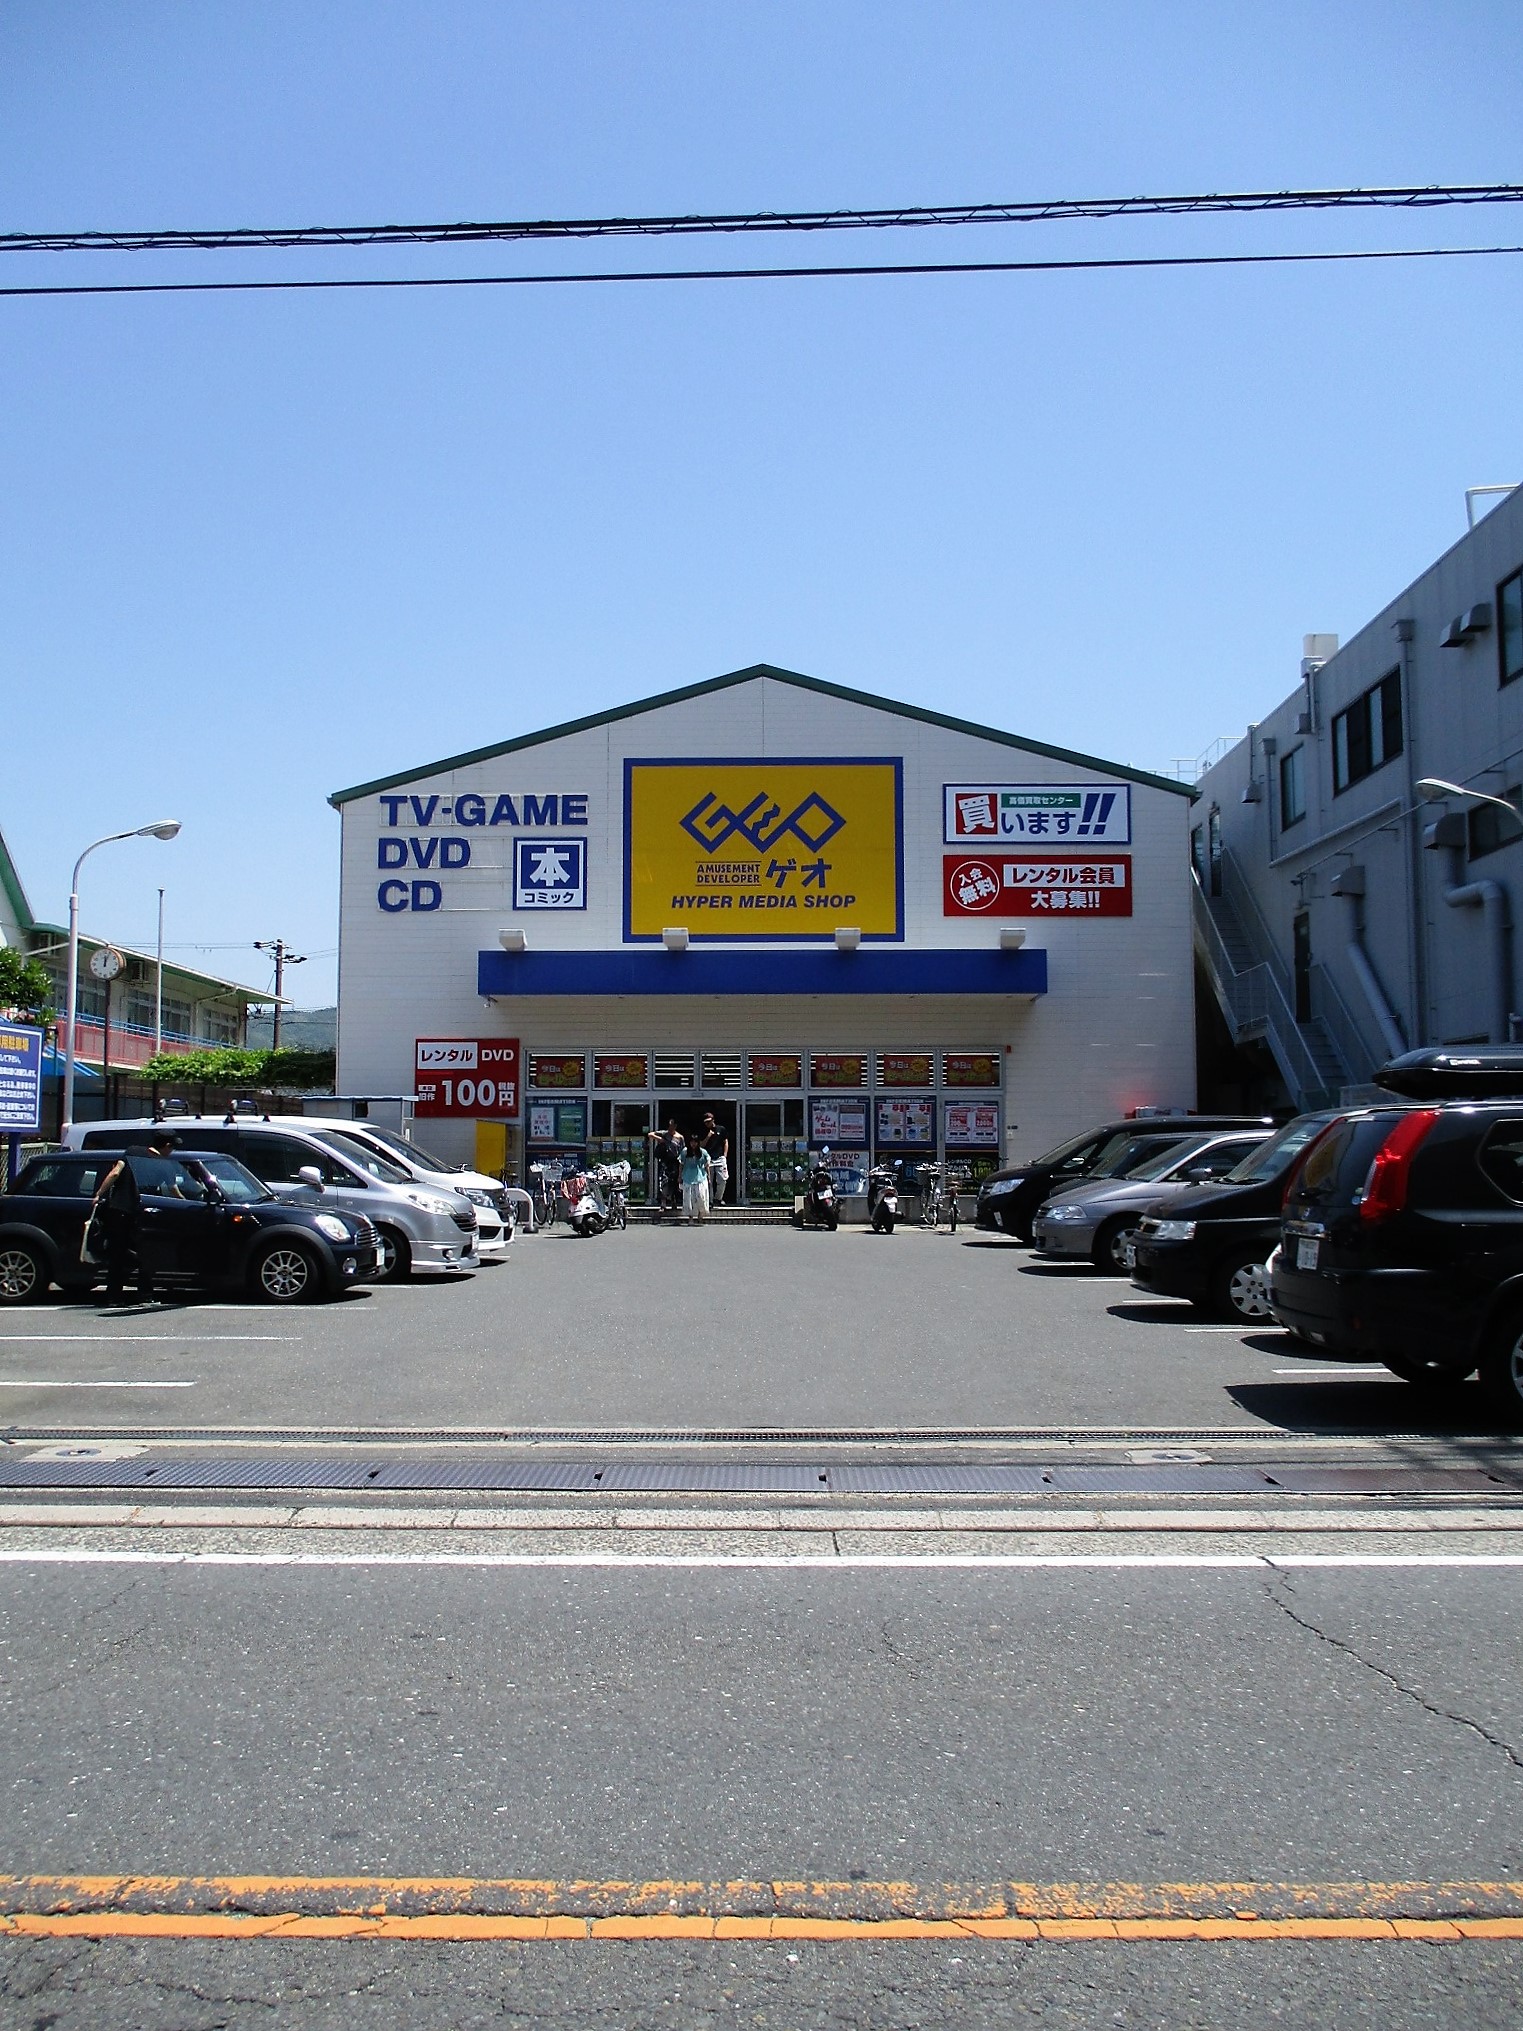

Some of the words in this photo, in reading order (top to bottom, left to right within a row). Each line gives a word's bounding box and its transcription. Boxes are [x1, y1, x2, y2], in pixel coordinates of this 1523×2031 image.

[379, 793, 588, 827] TV-GAME
[679, 791, 847, 853] GEO
[377, 837, 472, 869] DVD
[529, 847, 571, 887] 本
[696, 864, 761, 873] AMUSEMENT
[766, 857, 833, 888] ゲオ
[958, 867, 983, 887] 入会
[1012, 867, 1116, 885] レンタル会員
[696, 875, 761, 884] DEVELOPER
[958, 876, 997, 905] 無料
[377, 879, 443, 913] CD
[523, 891, 575, 905] コミック
[671, 895, 732, 909] HYPER
[738, 895, 799, 908] MEDIA
[804, 895, 856, 908] SHOP
[421, 1049, 473, 1062] レンタル
[481, 1049, 515, 1061] DVD
